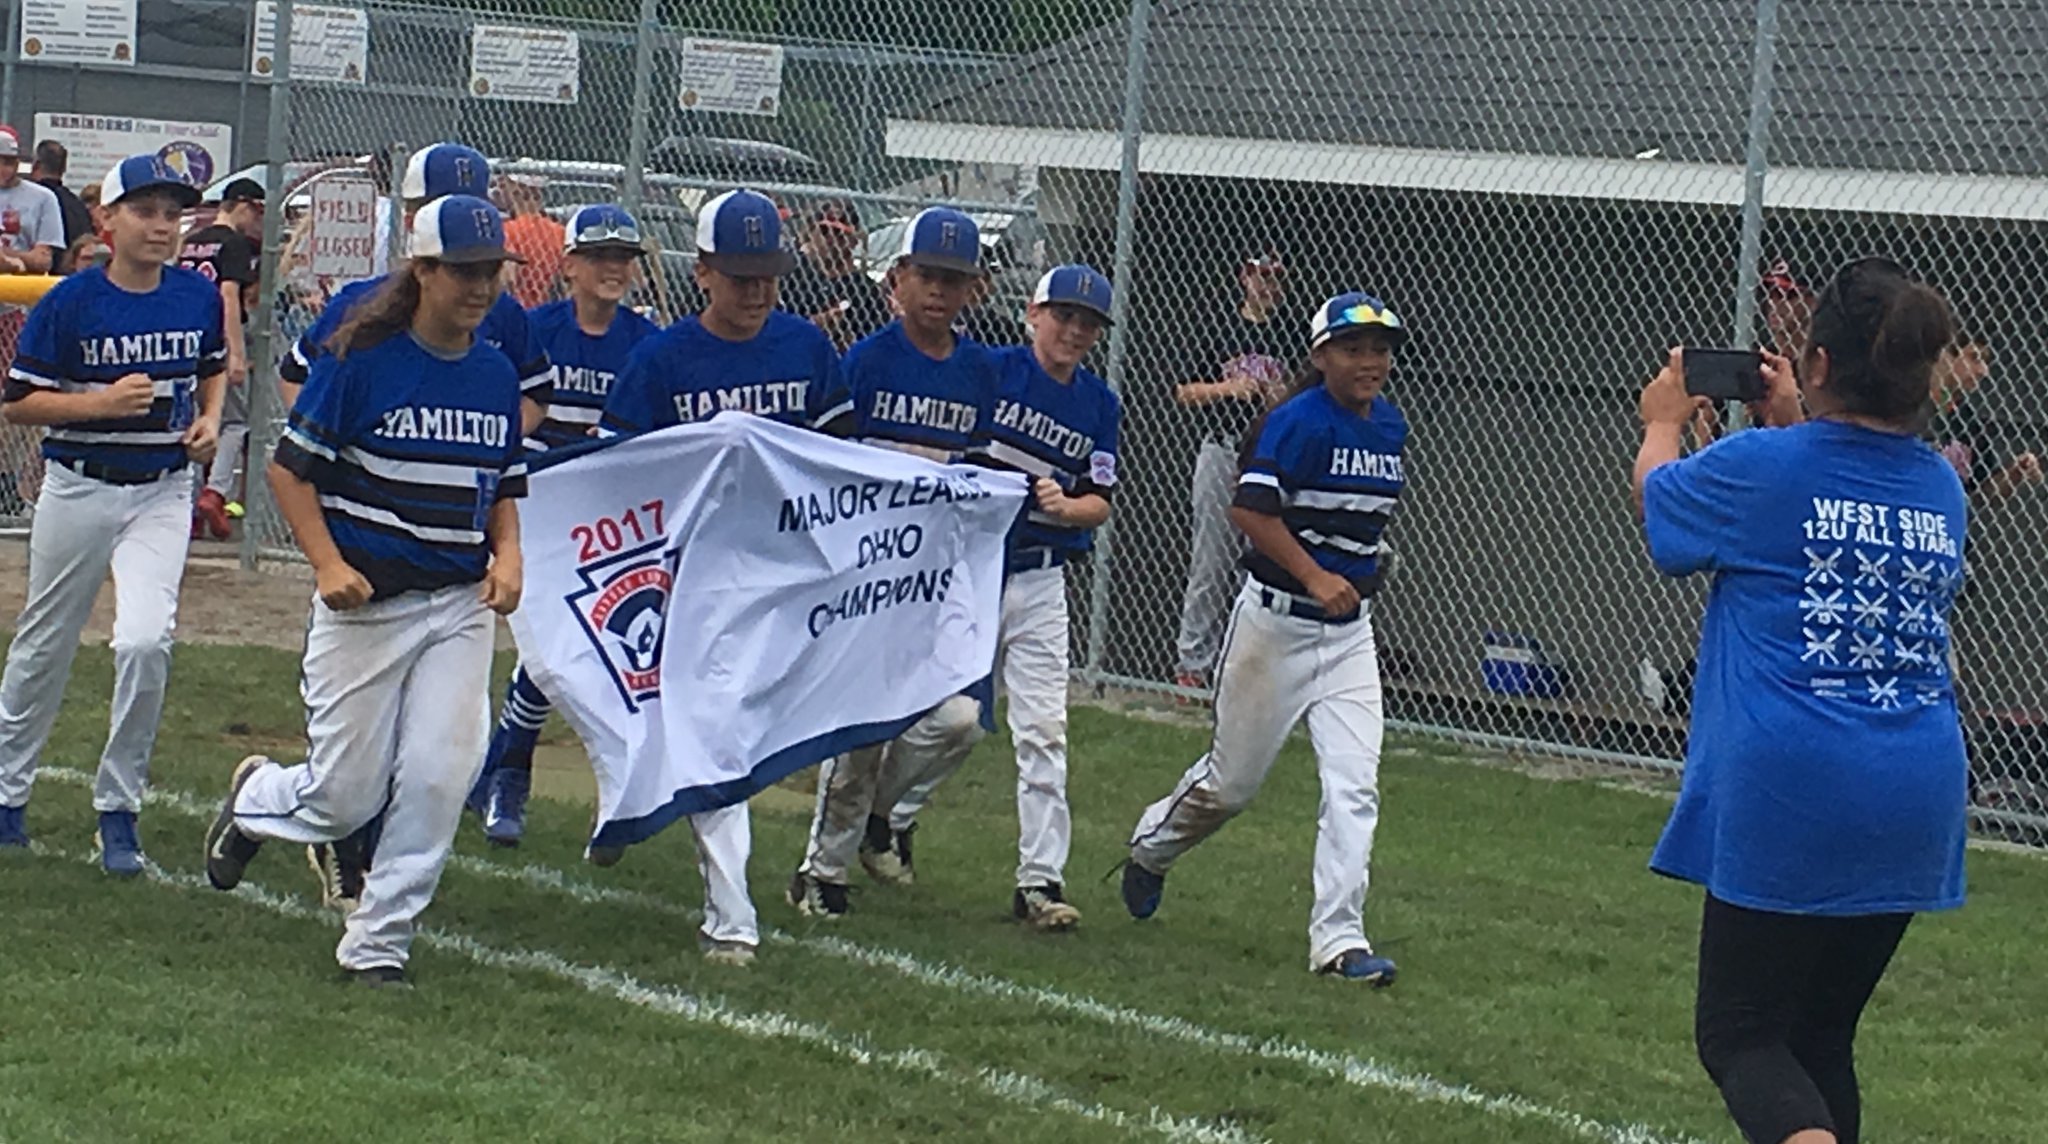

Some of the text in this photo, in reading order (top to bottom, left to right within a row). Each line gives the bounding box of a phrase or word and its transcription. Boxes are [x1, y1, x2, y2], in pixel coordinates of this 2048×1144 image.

[50, 116, 133, 133] REMINDERS
[319, 201, 368, 223] FIELD
[314, 236, 371, 257] CLOSED
[940, 221, 961, 249] H
[80, 330, 203, 366] HAMILTO
[872, 391, 977, 434] HAMILTO
[778, 471, 992, 532] MAJOR LEA
[1813, 497, 1948, 537] WEST SIDE
[571, 499, 664, 562] 2017
[857, 523, 923, 569] OHIO
[1802, 519, 1847, 541] 12U
[1855, 525, 1895, 548] ALL
